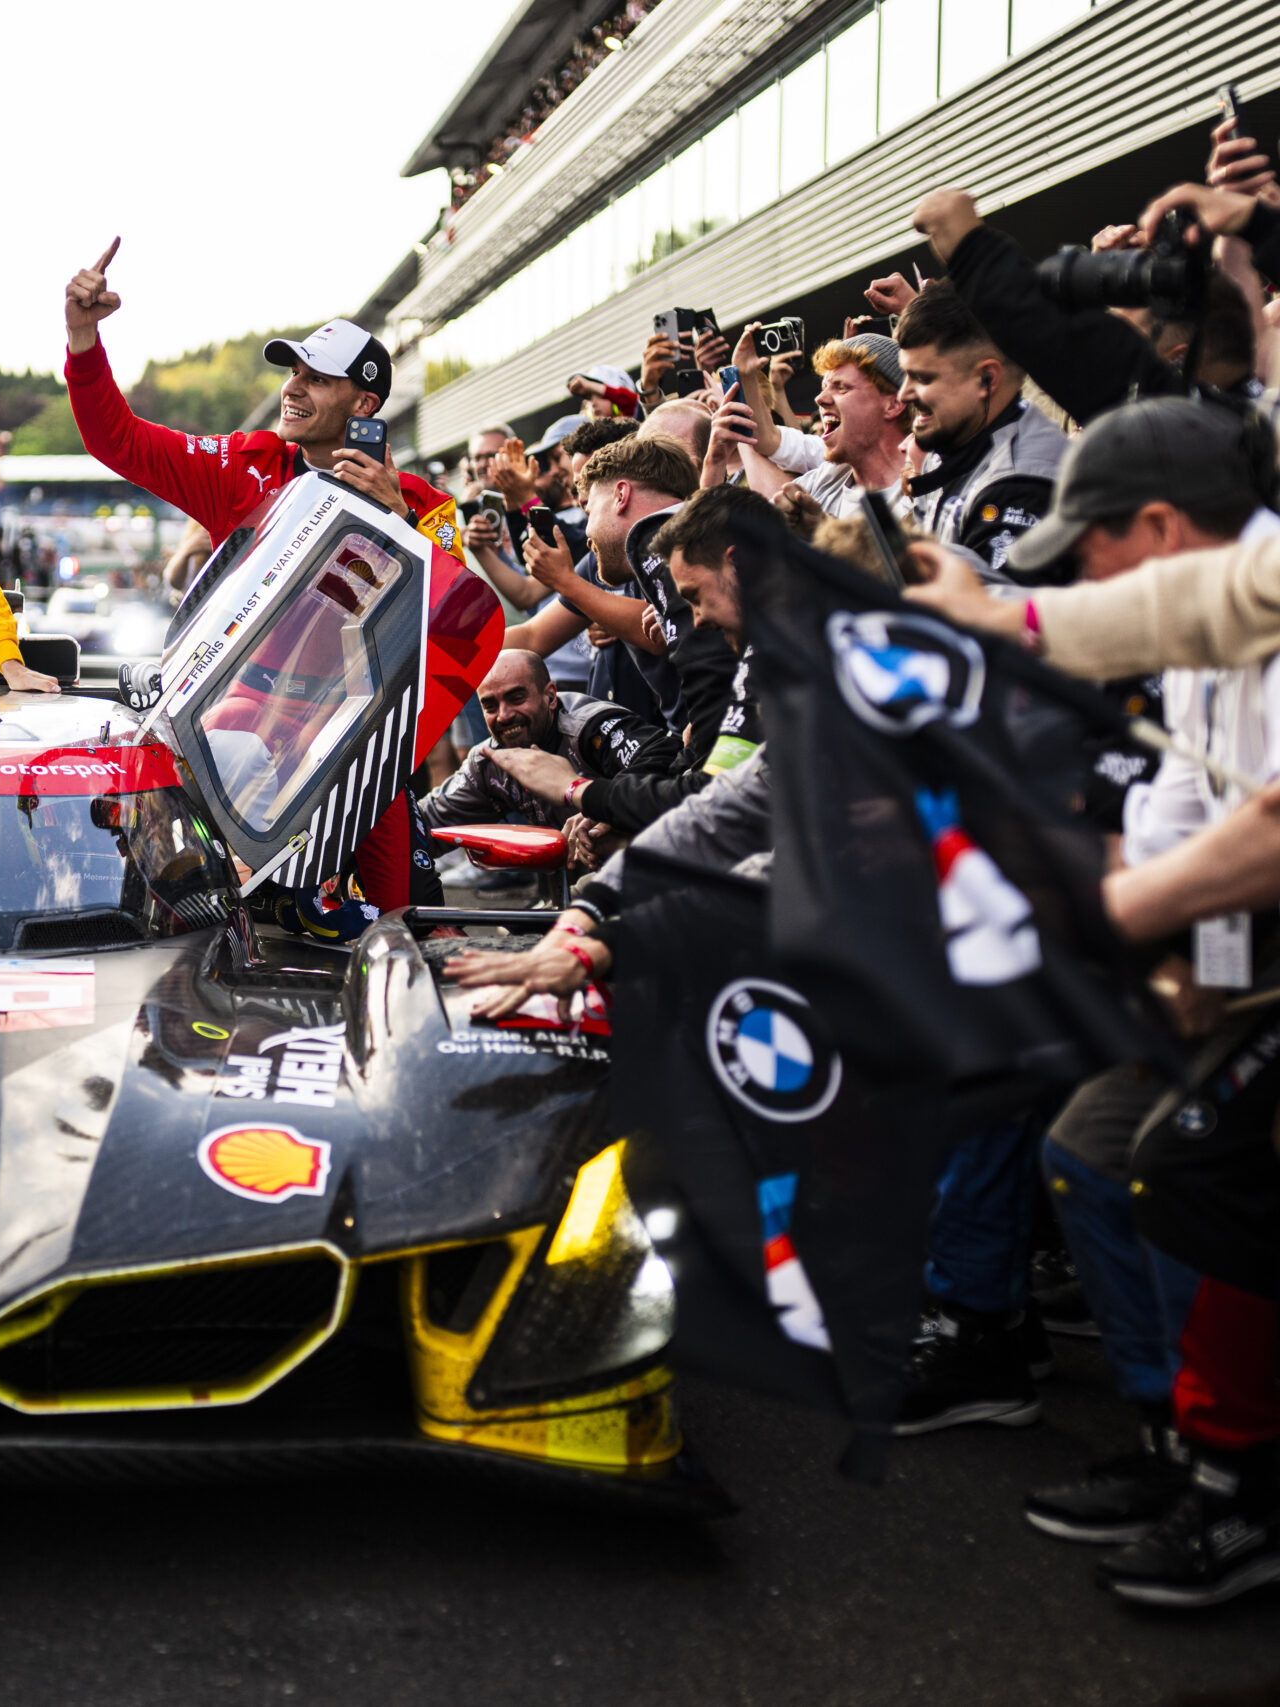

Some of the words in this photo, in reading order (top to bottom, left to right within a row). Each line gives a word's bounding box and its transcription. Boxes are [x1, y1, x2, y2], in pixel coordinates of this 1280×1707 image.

[221, 437, 229, 469] HELIX
[190, 639, 224, 680] FRIJNS
[235, 591, 263, 623] RAST
[272, 549, 294, 574] VAN
[293, 525, 313, 551] DER
[309, 494, 339, 526] LINDE
[273, 1020, 348, 1109] HELIX
[436, 1040, 480, 1054] Our
[483, 1042, 538, 1055] Hero
[219, 1054, 273, 1100] Shell
